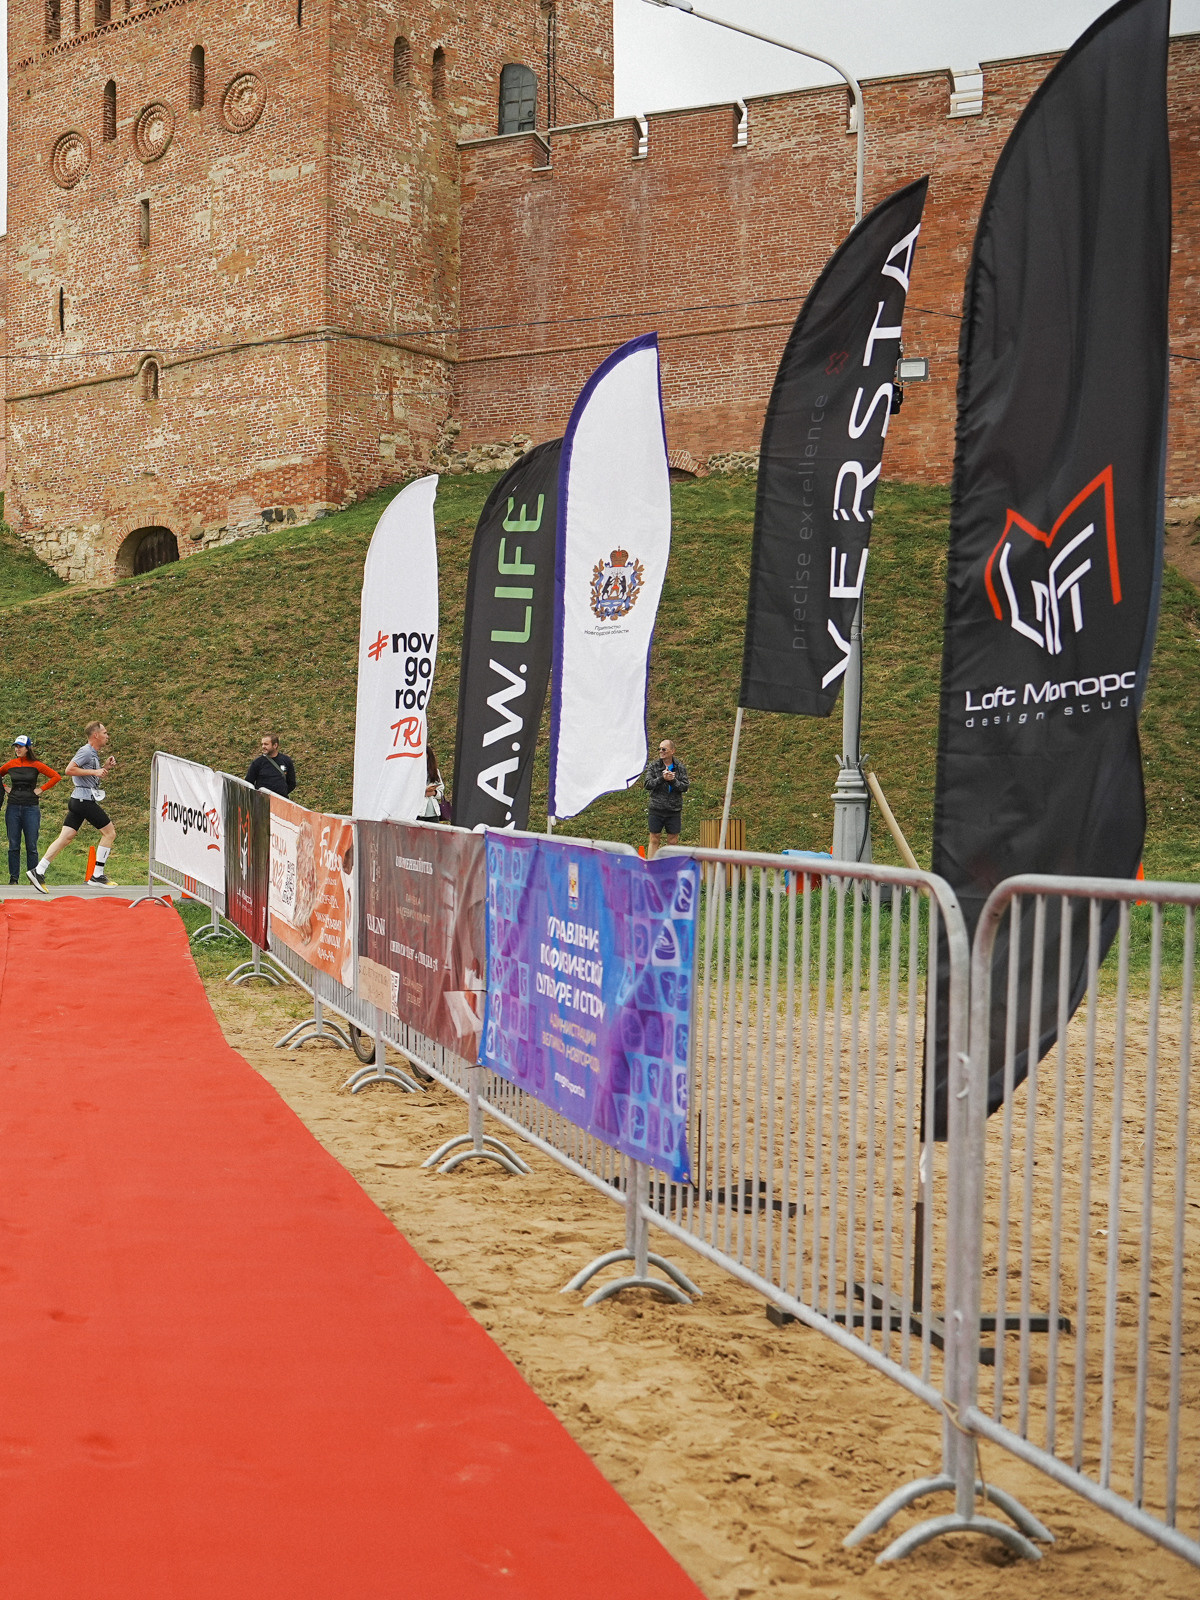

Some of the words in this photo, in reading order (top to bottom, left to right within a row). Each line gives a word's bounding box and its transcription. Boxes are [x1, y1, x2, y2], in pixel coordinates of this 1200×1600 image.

[798, 393, 828, 540] excellence
[821, 222, 921, 690] VERSTA
[490, 493, 545, 643] LIFE
[790, 552, 812, 650] precise
[367, 630, 435, 661] #nov
[404, 656, 432, 687] go
[965, 685, 1016, 712] Loft
[965, 710, 1045, 728] design
[1063, 696, 1130, 716] stud
